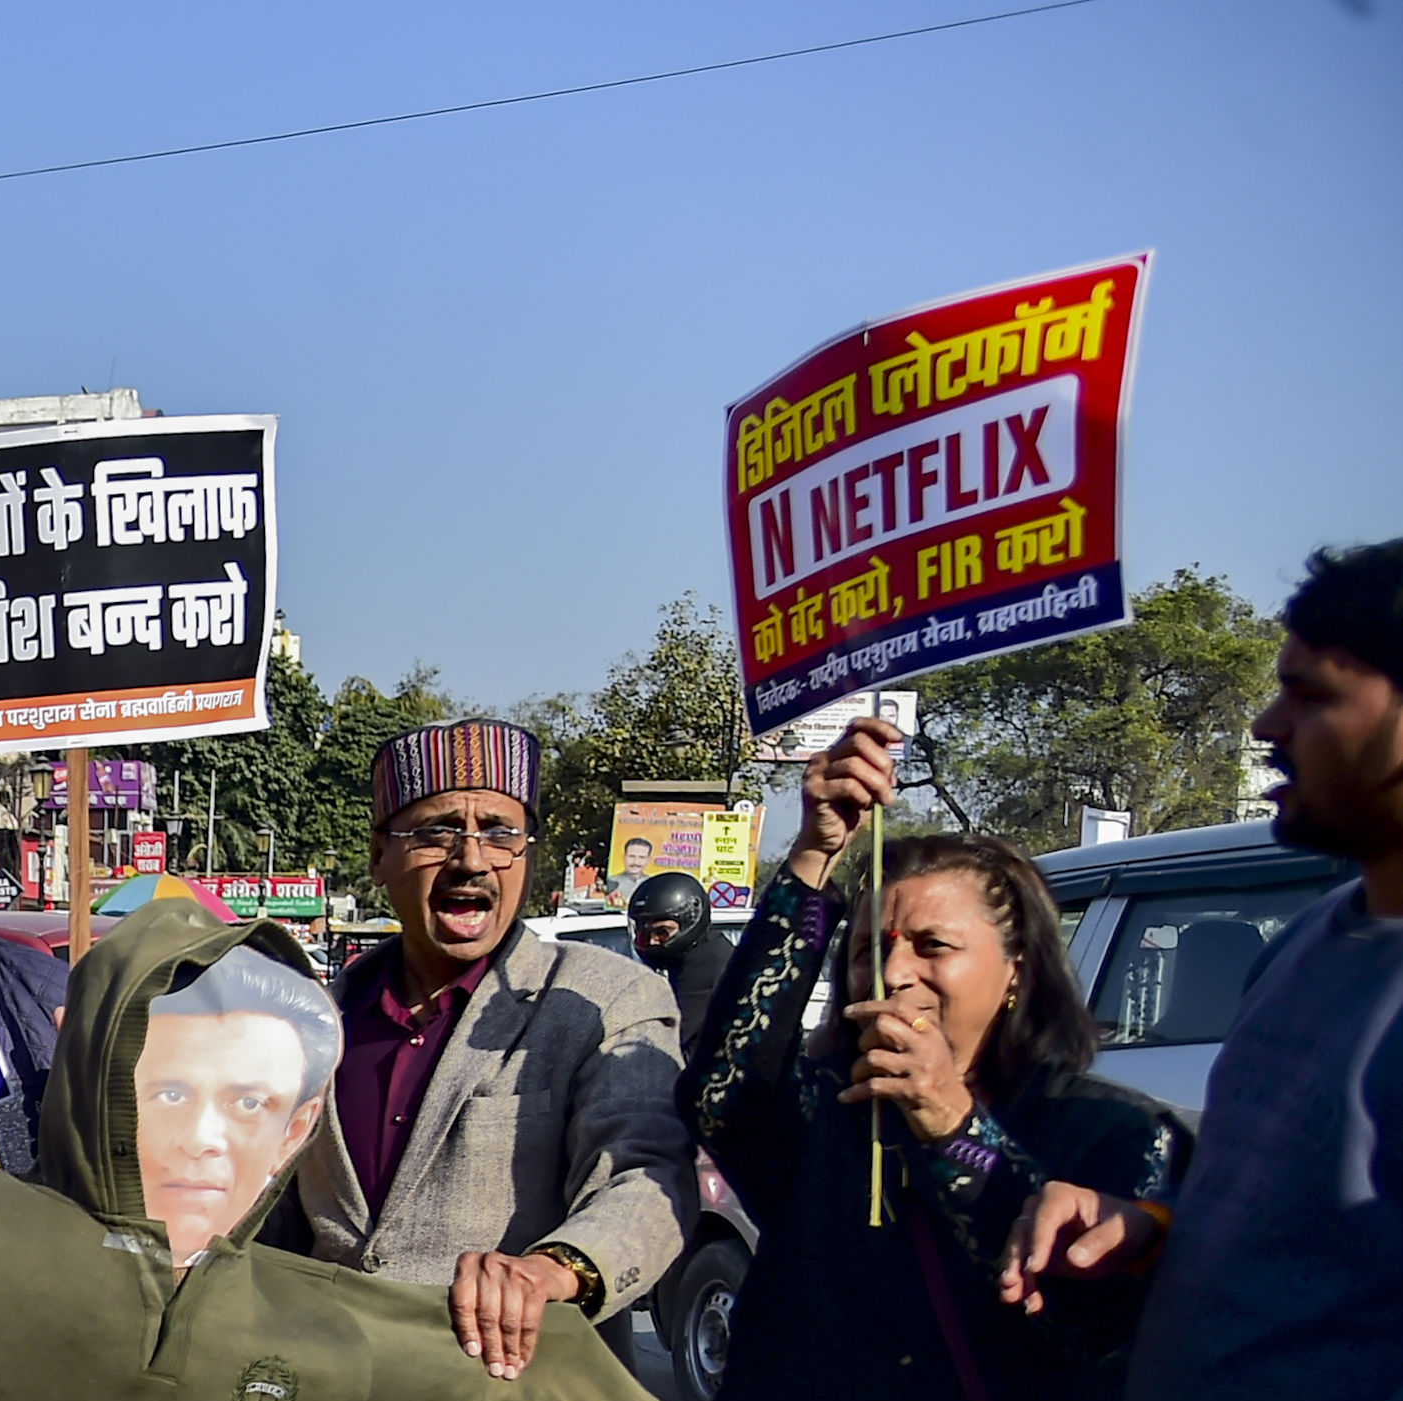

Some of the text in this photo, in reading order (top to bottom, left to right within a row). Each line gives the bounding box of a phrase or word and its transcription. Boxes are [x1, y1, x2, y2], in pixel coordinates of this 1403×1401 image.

[737, 372, 857, 494] डिजिटल
[33, 467, 83, 551] के
[92, 457, 258, 547] खिलाफ
[760, 404, 1051, 588] N NETFLIX
[63, 584, 163, 655] बन्द
[168, 562, 248, 648] करो
[753, 497, 1088, 664] को बंद करो, FIR करो
[7, 703, 76, 730] परशुराम
[80, 698, 117, 721] सेना
[194, 689, 244, 713] प्रयागराज
[276, 882, 318, 898] शराब
